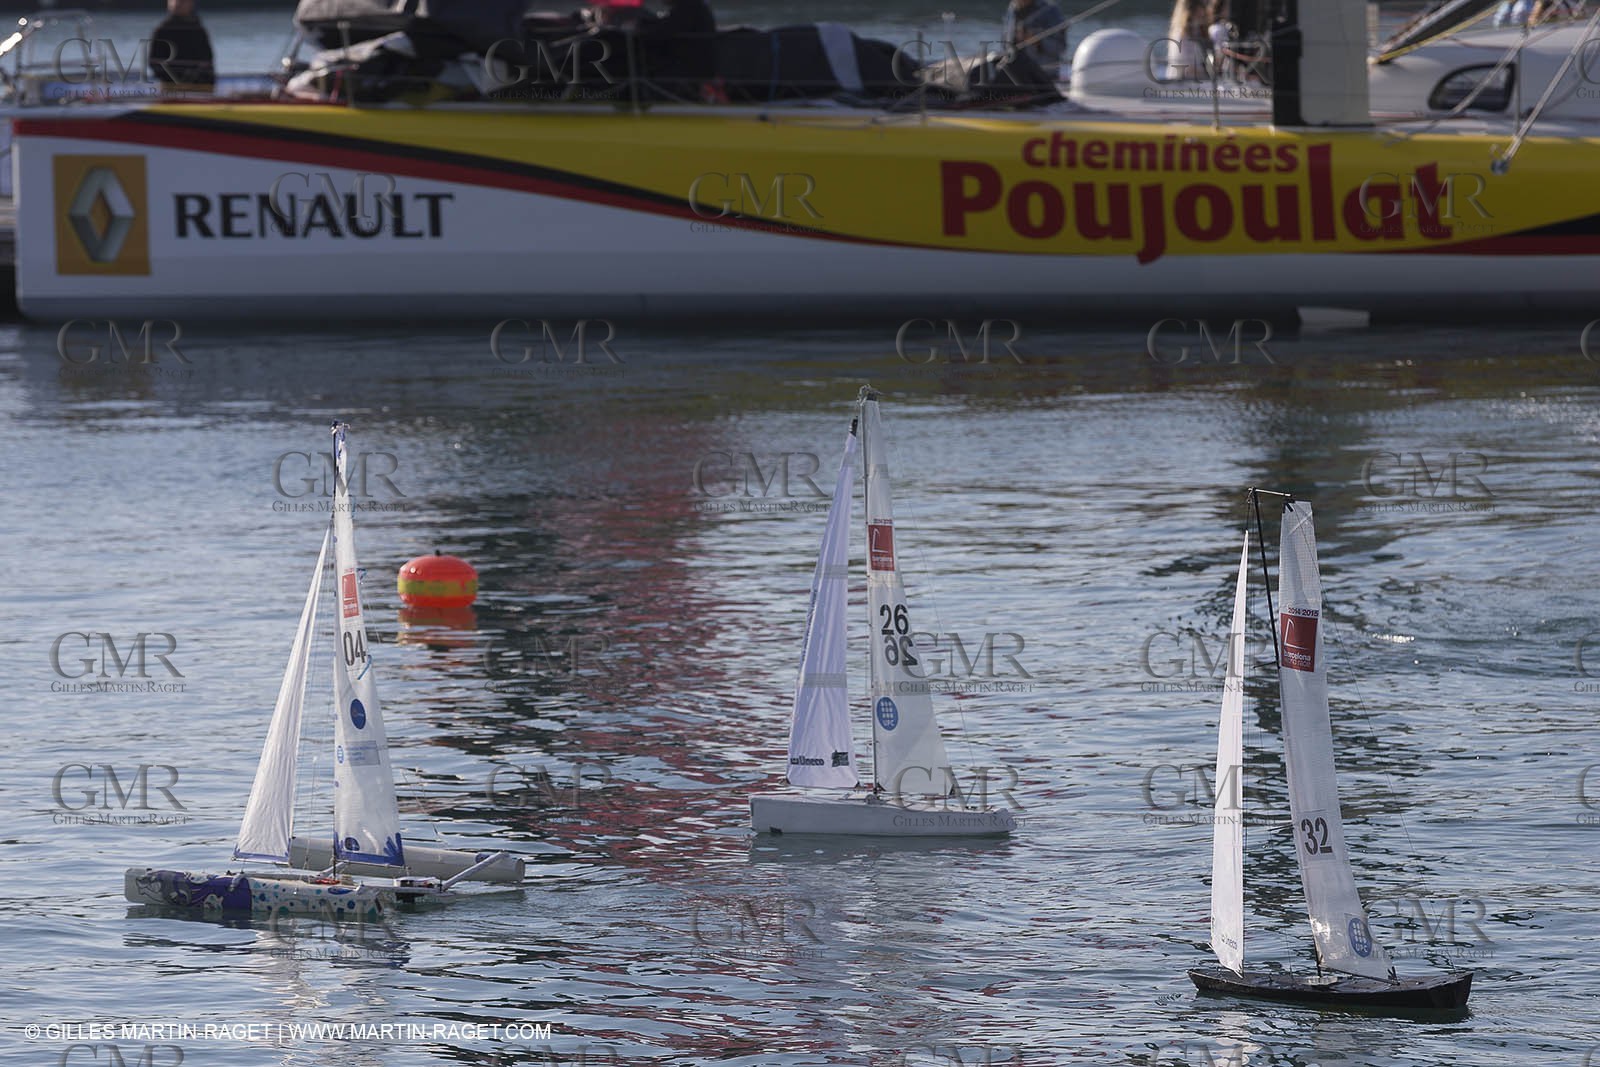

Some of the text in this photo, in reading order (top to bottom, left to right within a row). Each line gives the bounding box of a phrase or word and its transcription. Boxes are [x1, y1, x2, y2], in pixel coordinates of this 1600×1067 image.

[1022, 131, 1298, 172] cheminées
[172, 193, 454, 238] RENAULT
[940, 143, 1452, 265] Poujoulat
[880, 604, 909, 635] 26
[343, 630, 366, 666] 04
[1301, 817, 1333, 856] 32
